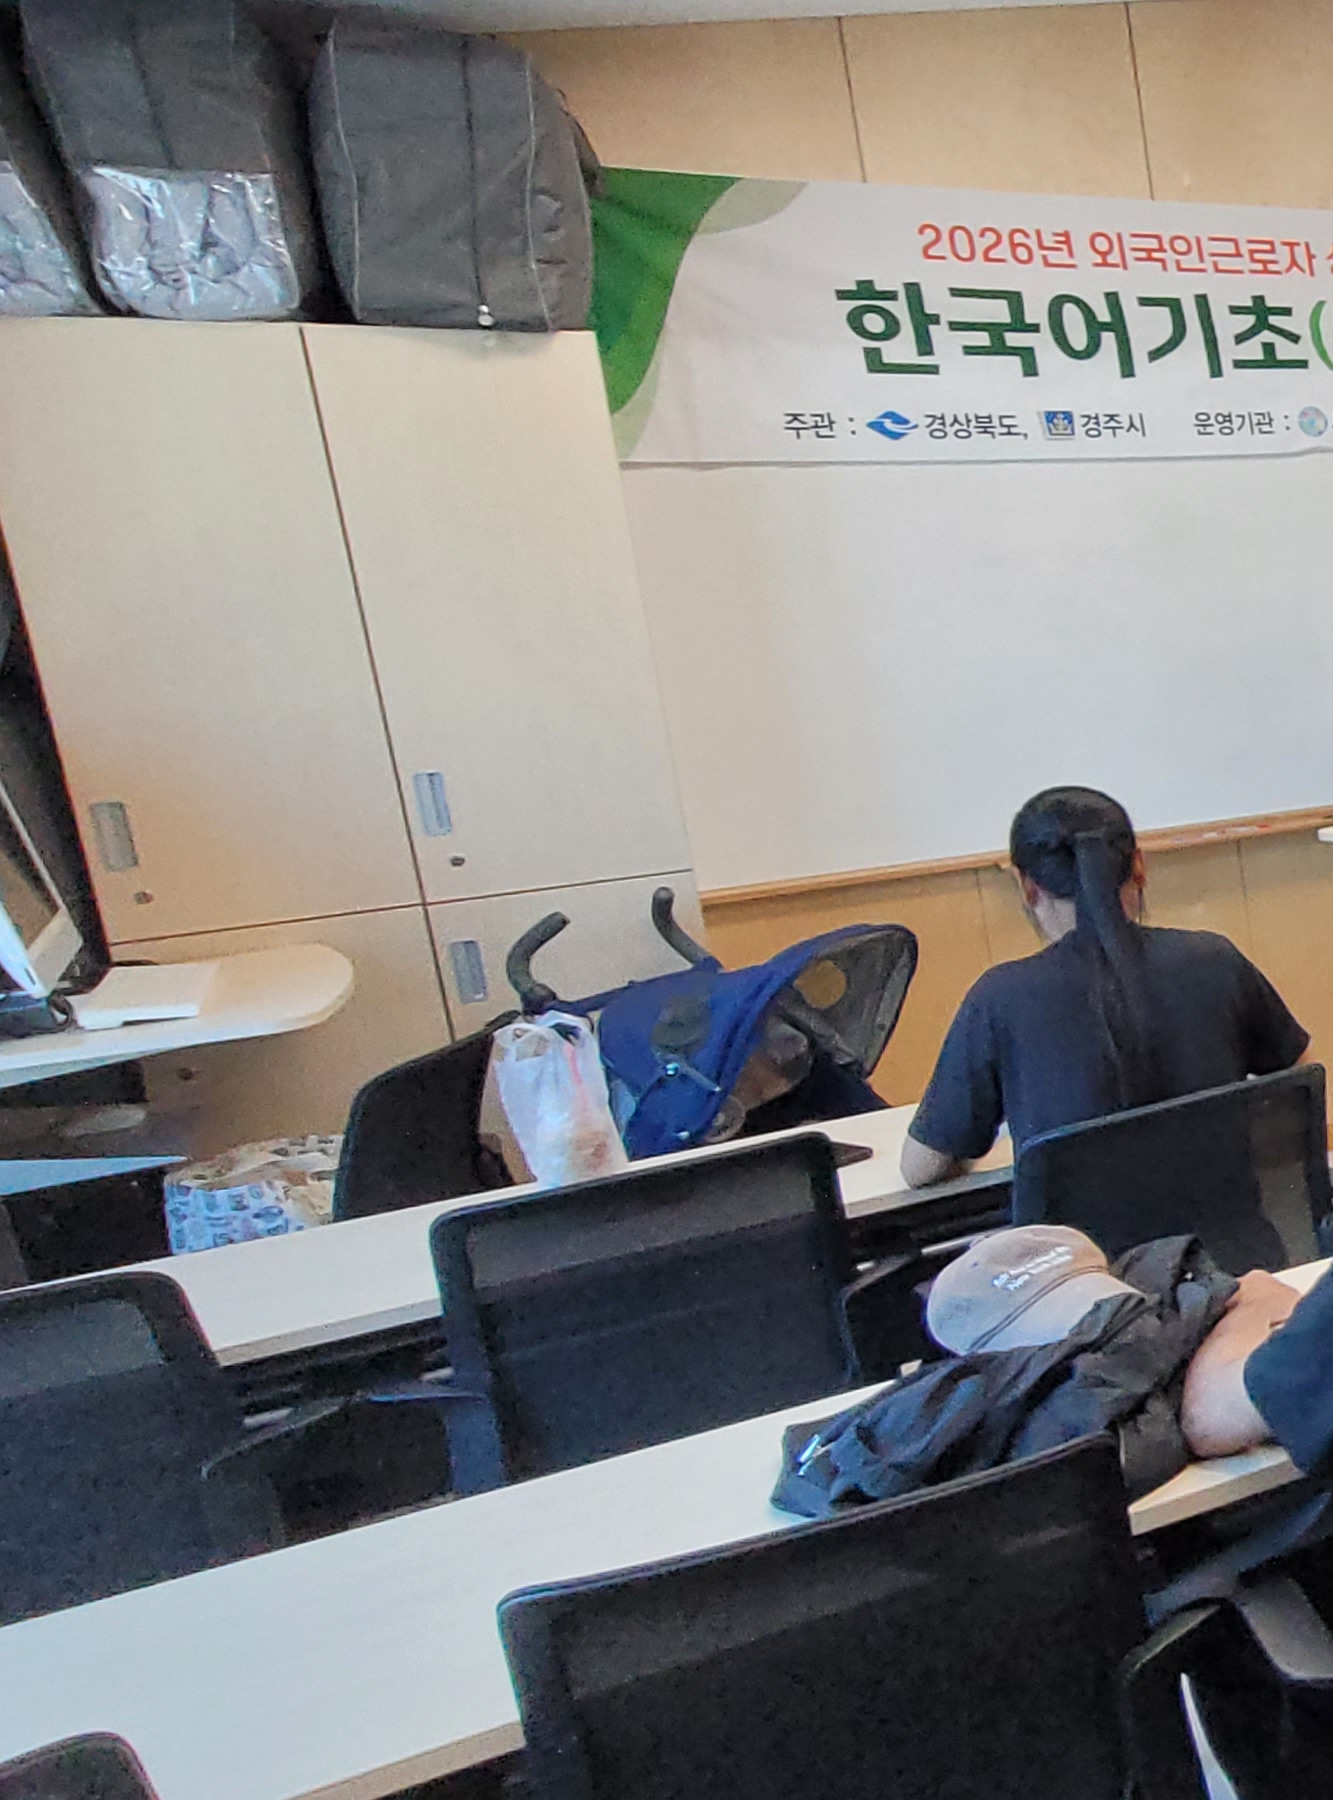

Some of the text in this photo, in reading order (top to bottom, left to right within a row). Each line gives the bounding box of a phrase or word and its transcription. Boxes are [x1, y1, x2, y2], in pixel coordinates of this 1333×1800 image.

[917, 223, 1078, 268] 2026년
[1088, 230, 1316, 277] 외국인근로자
[783, 412, 836, 439] 주관
[923, 412, 1028, 440] 경상북도,
[1080, 412, 1146, 438] 경주시
[1193, 411, 1275, 436] 운영기관
